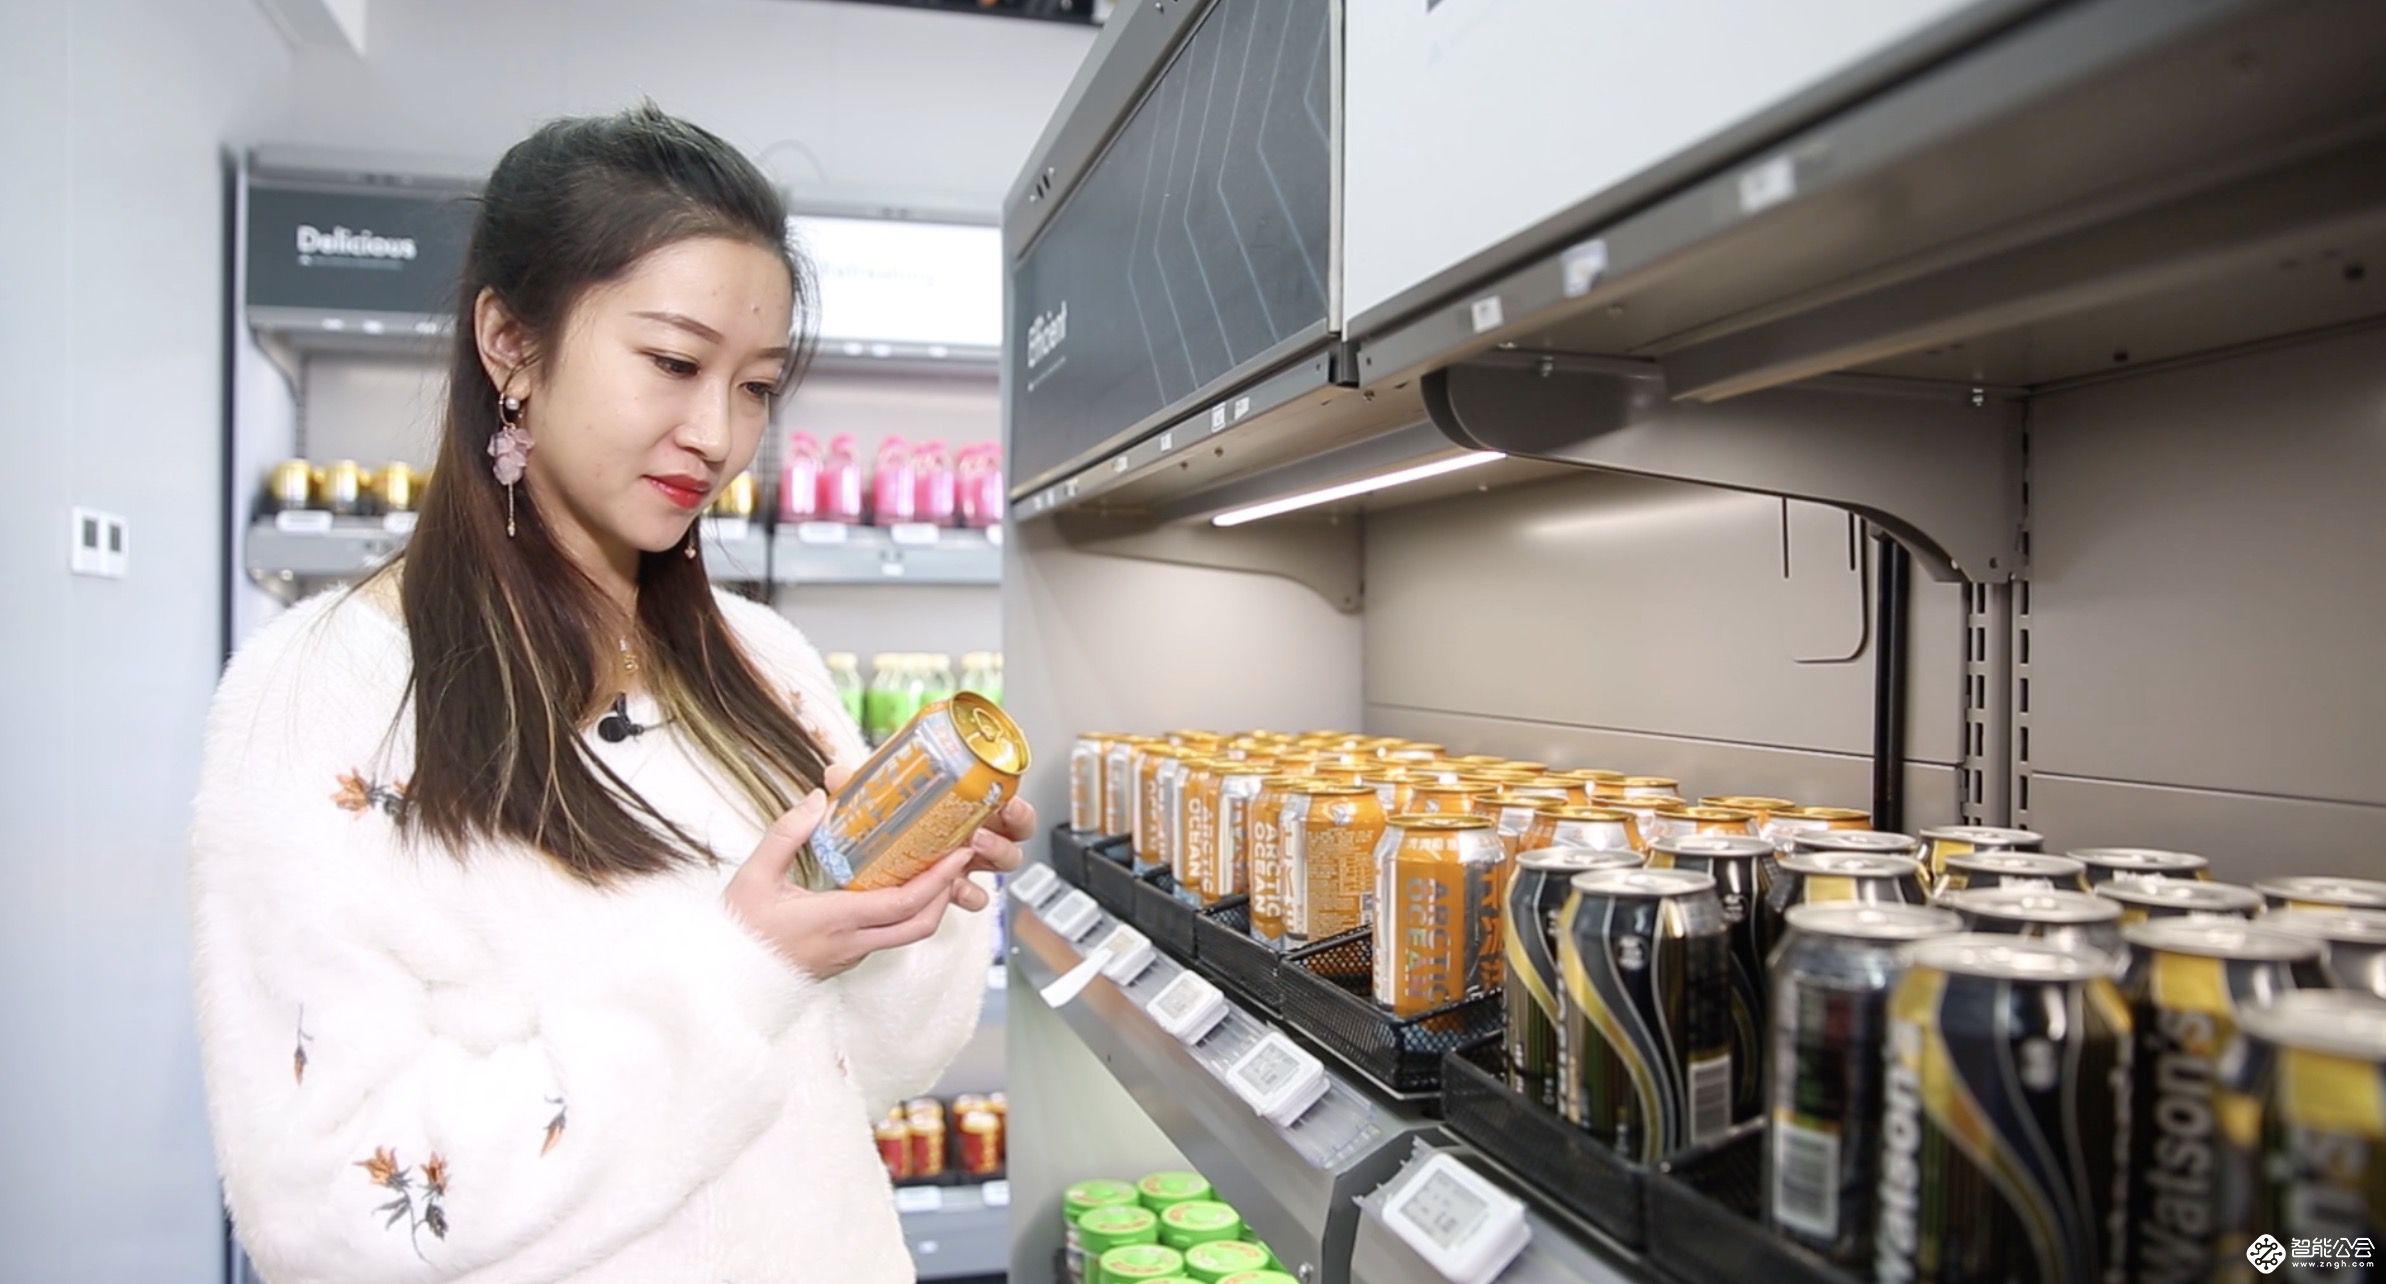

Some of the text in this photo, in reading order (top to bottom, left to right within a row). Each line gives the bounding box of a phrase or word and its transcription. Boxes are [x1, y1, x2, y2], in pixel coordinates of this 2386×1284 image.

[296, 224, 417, 260] Delicious
[1188, 798, 1201, 877] OCEAN
[1254, 821, 1266, 913] OCEAN
[1266, 823, 1281, 917] ARCTIC
[1405, 876, 1427, 997] OCEAN
[1429, 877, 1451, 1001] ARCTIC
